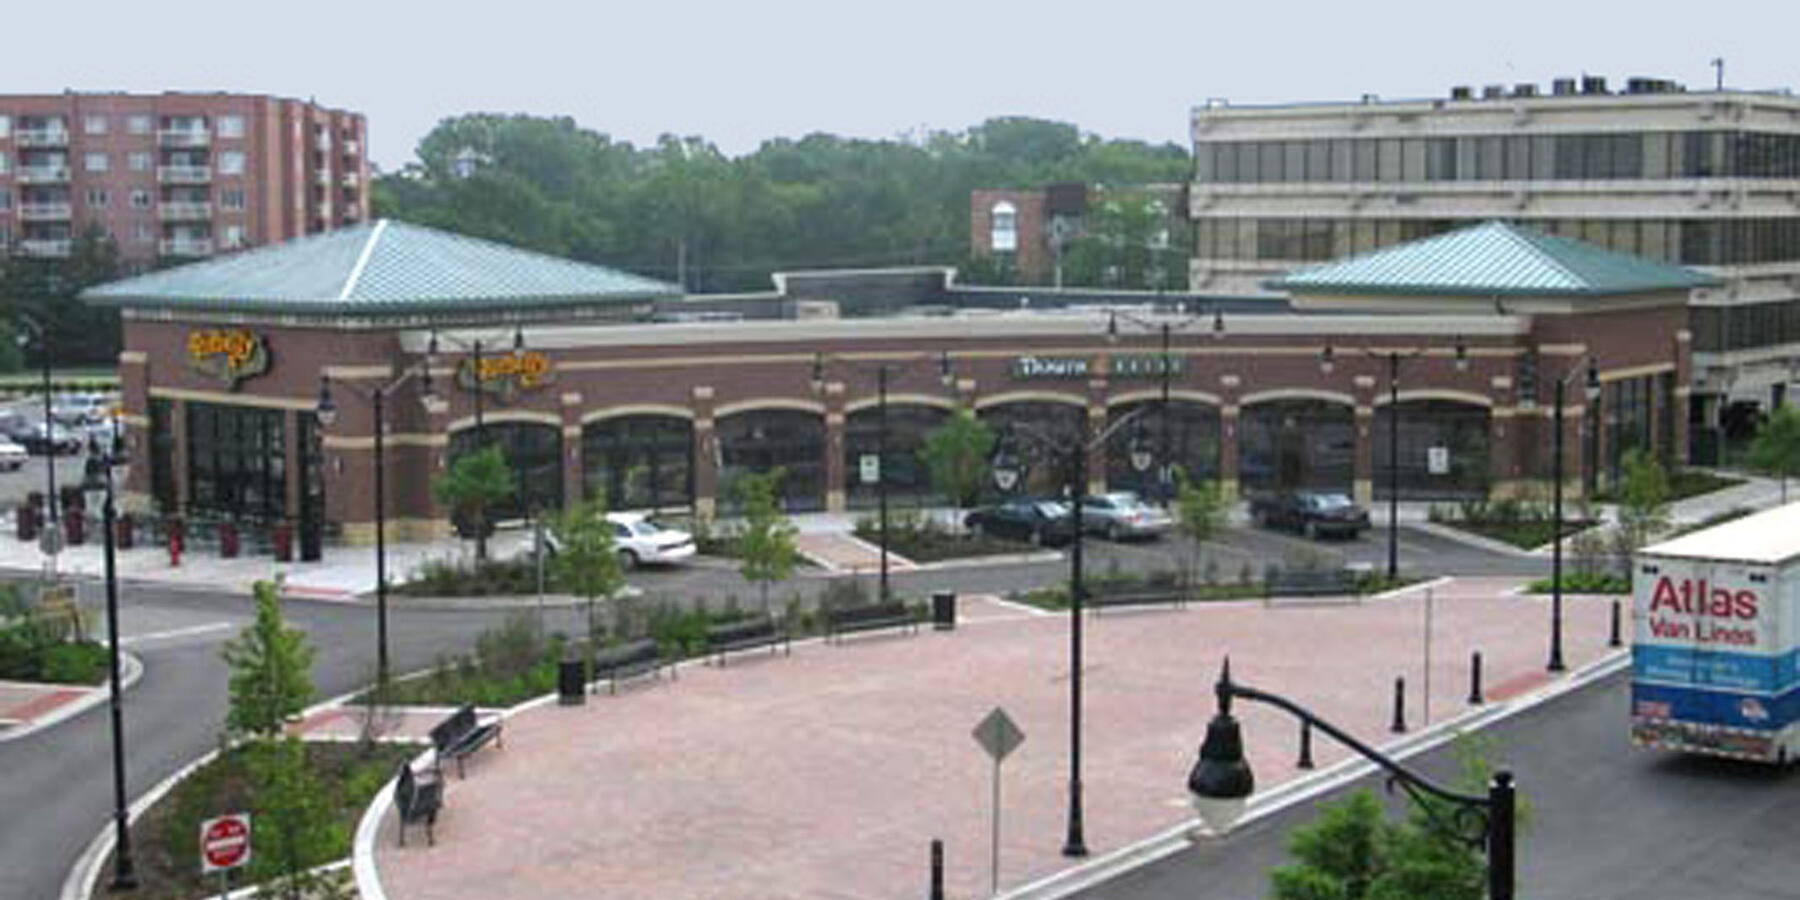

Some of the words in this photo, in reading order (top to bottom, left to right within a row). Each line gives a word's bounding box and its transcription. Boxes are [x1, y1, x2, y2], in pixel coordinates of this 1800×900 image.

[1650, 576, 1758, 620] Atlas
[1650, 616, 1689, 638] Van
[1696, 621, 1756, 645] Lines
